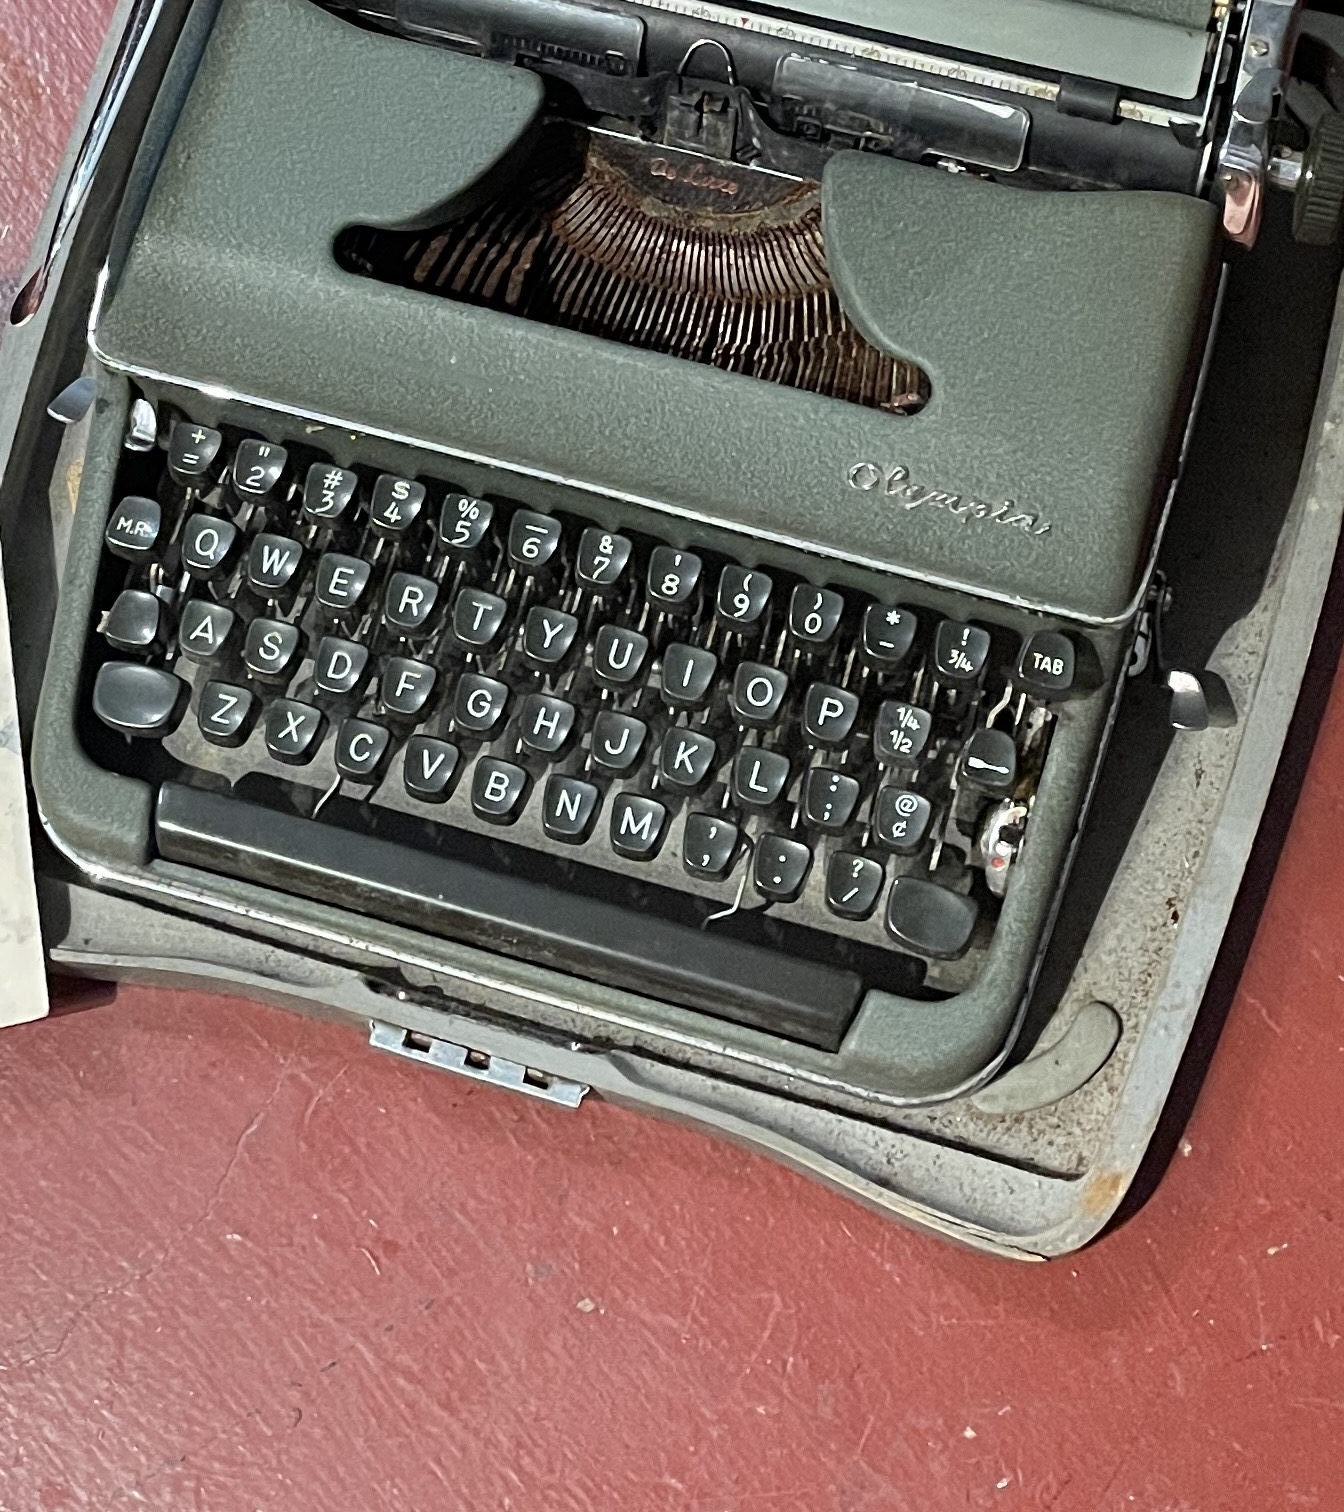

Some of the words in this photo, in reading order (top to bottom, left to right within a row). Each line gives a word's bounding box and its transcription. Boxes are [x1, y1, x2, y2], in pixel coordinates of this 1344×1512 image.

[246, 466, 265, 487] 2
[315, 490, 334, 513] 3
[384, 502, 401, 523] 4
[452, 521, 471, 544] 5
[522, 537, 541, 558] 6
[593, 556, 610, 579] 7
[661, 574, 680, 595] 8
[734, 593, 750, 617] 9
[948, 649, 973, 672] 3/4
[1034, 653, 1064, 675] TAB
[847, 462, 1052, 536] Olympia
[190, 616, 213, 644] A
[259, 632, 283, 660] S
[326, 651, 352, 680] D
[396, 671, 422, 697] F
[467, 689, 492, 717] G
[533, 707, 560, 738] H
[605, 728, 629, 755] J
[674, 741, 698, 773] K
[749, 760, 768, 793] L
[895, 794, 918, 816] @
[195, 529, 219, 560] Q
[262, 545, 289, 576] W
[328, 567, 355, 597] E
[399, 586, 423, 616] R
[472, 601, 492, 630] T
[543, 619, 563, 648] Y
[608, 638, 633, 669] U
[747, 677, 773, 706] O
[817, 697, 843, 725] P
[897, 707, 920, 730] 1/4
[210, 693, 238, 724] Z
[277, 712, 305, 742] X
[349, 733, 373, 762] C
[423, 749, 445, 779] V
[484, 771, 510, 802] B
[556, 789, 581, 821] N
[620, 805, 651, 840] M
[890, 730, 913, 754] 1/2
